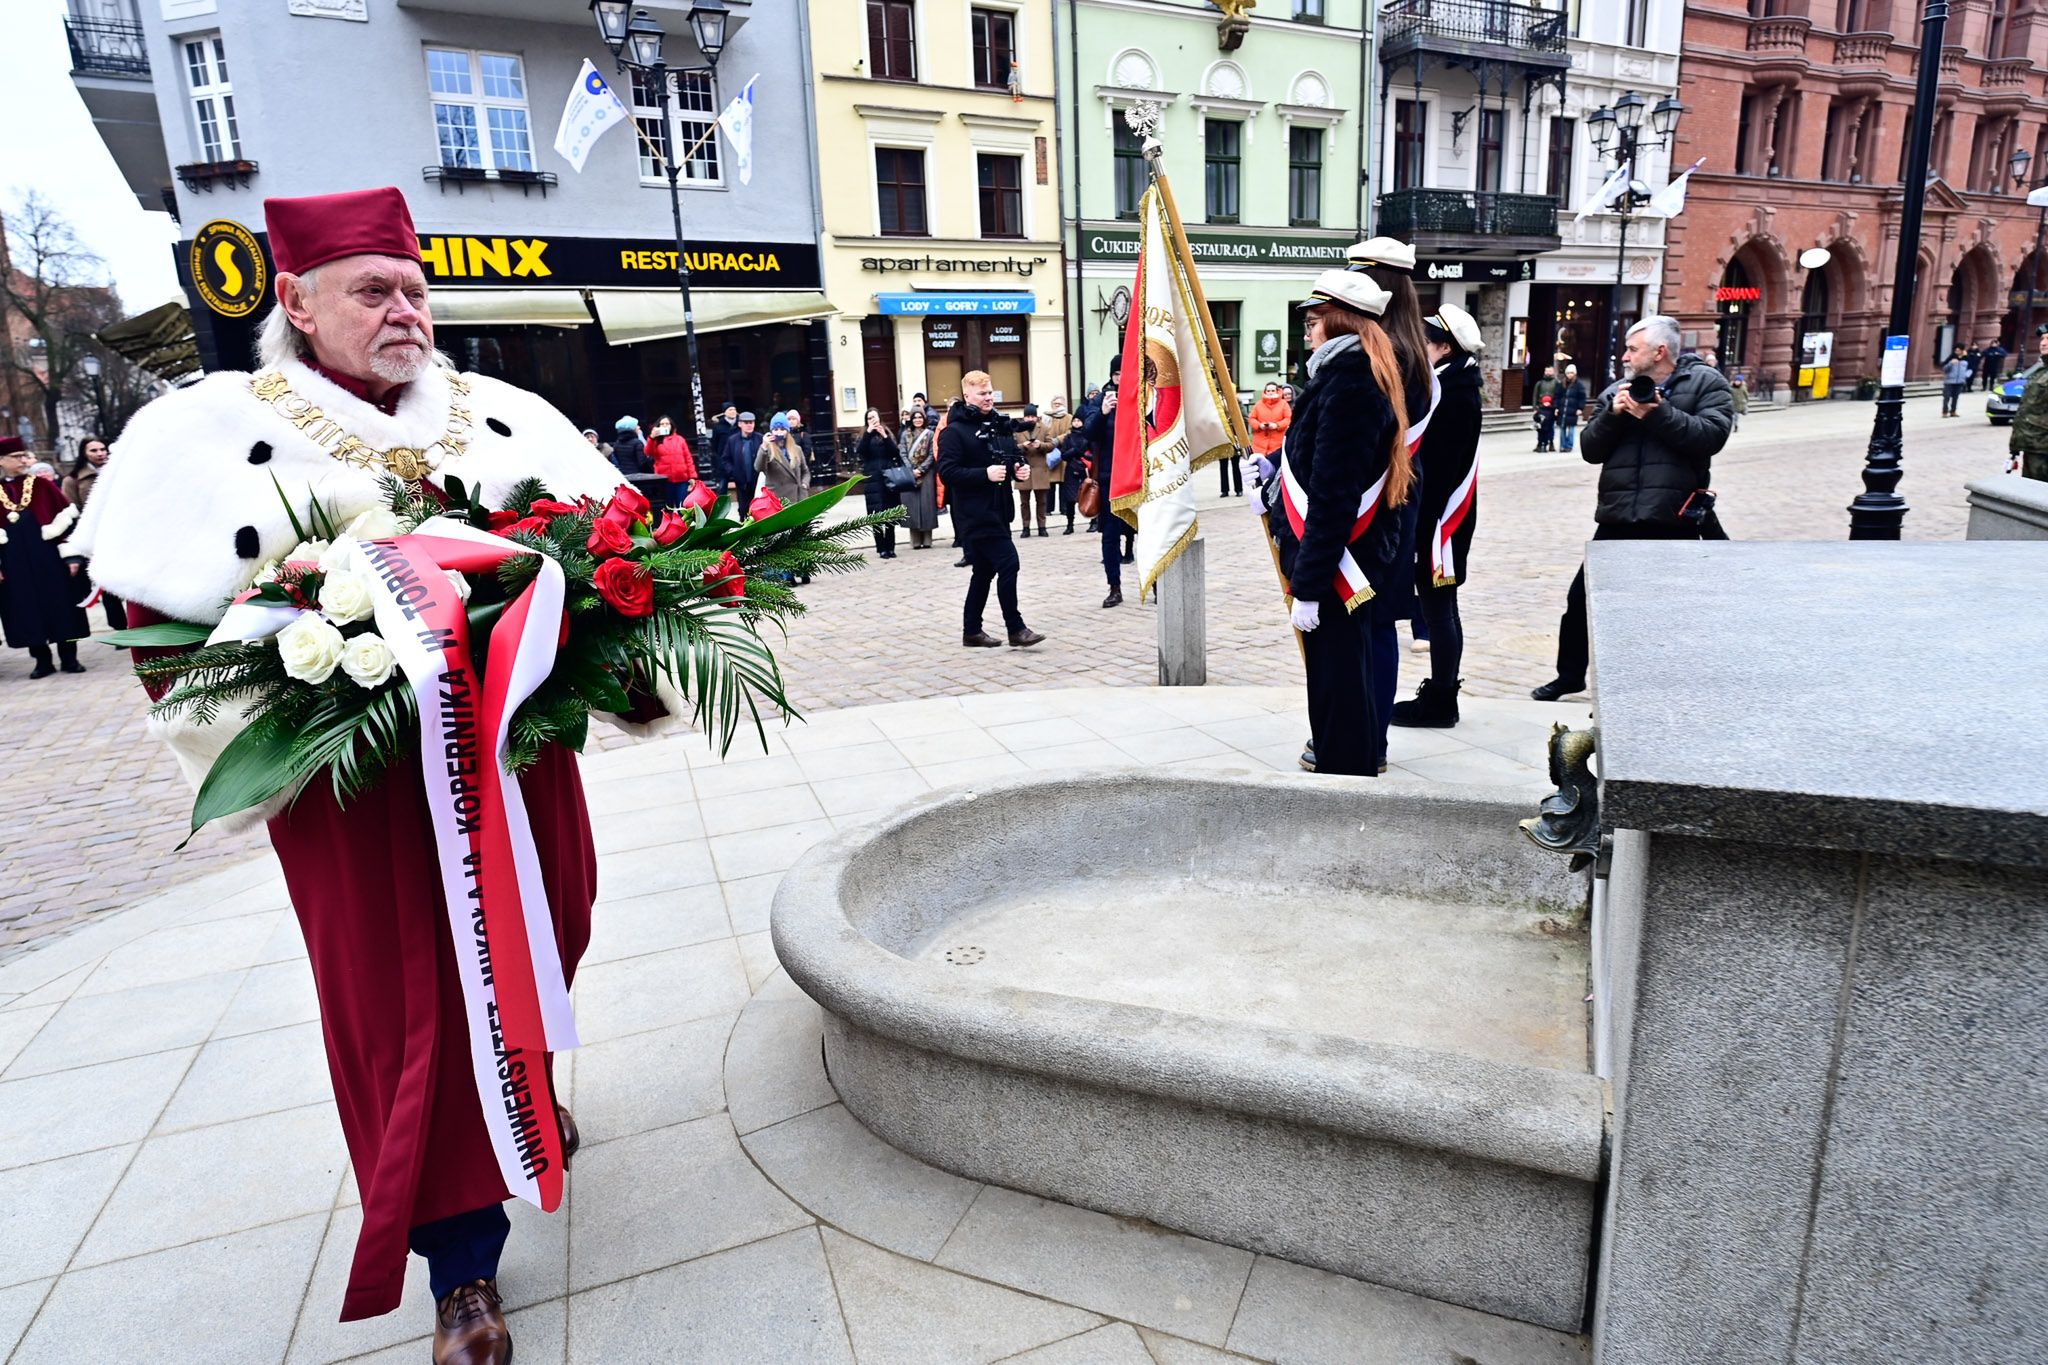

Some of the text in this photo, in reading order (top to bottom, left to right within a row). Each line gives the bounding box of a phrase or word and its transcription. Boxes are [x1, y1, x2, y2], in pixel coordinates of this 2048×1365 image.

[416, 237, 552, 277] HINX
[1091, 236, 1348, 259] CUKIER ESTAURACJA APARTAMENTY
[621, 250, 780, 272] RESTAURACJA
[901, 301, 1019, 311] LODY GOFRY LODY
[933, 323, 952, 331] LODY
[840, 335, 848, 346] 3
[357, 540, 437, 621] TORUNI
[417, 628, 459, 653] W
[438, 668, 481, 835] KOPERNIKA
